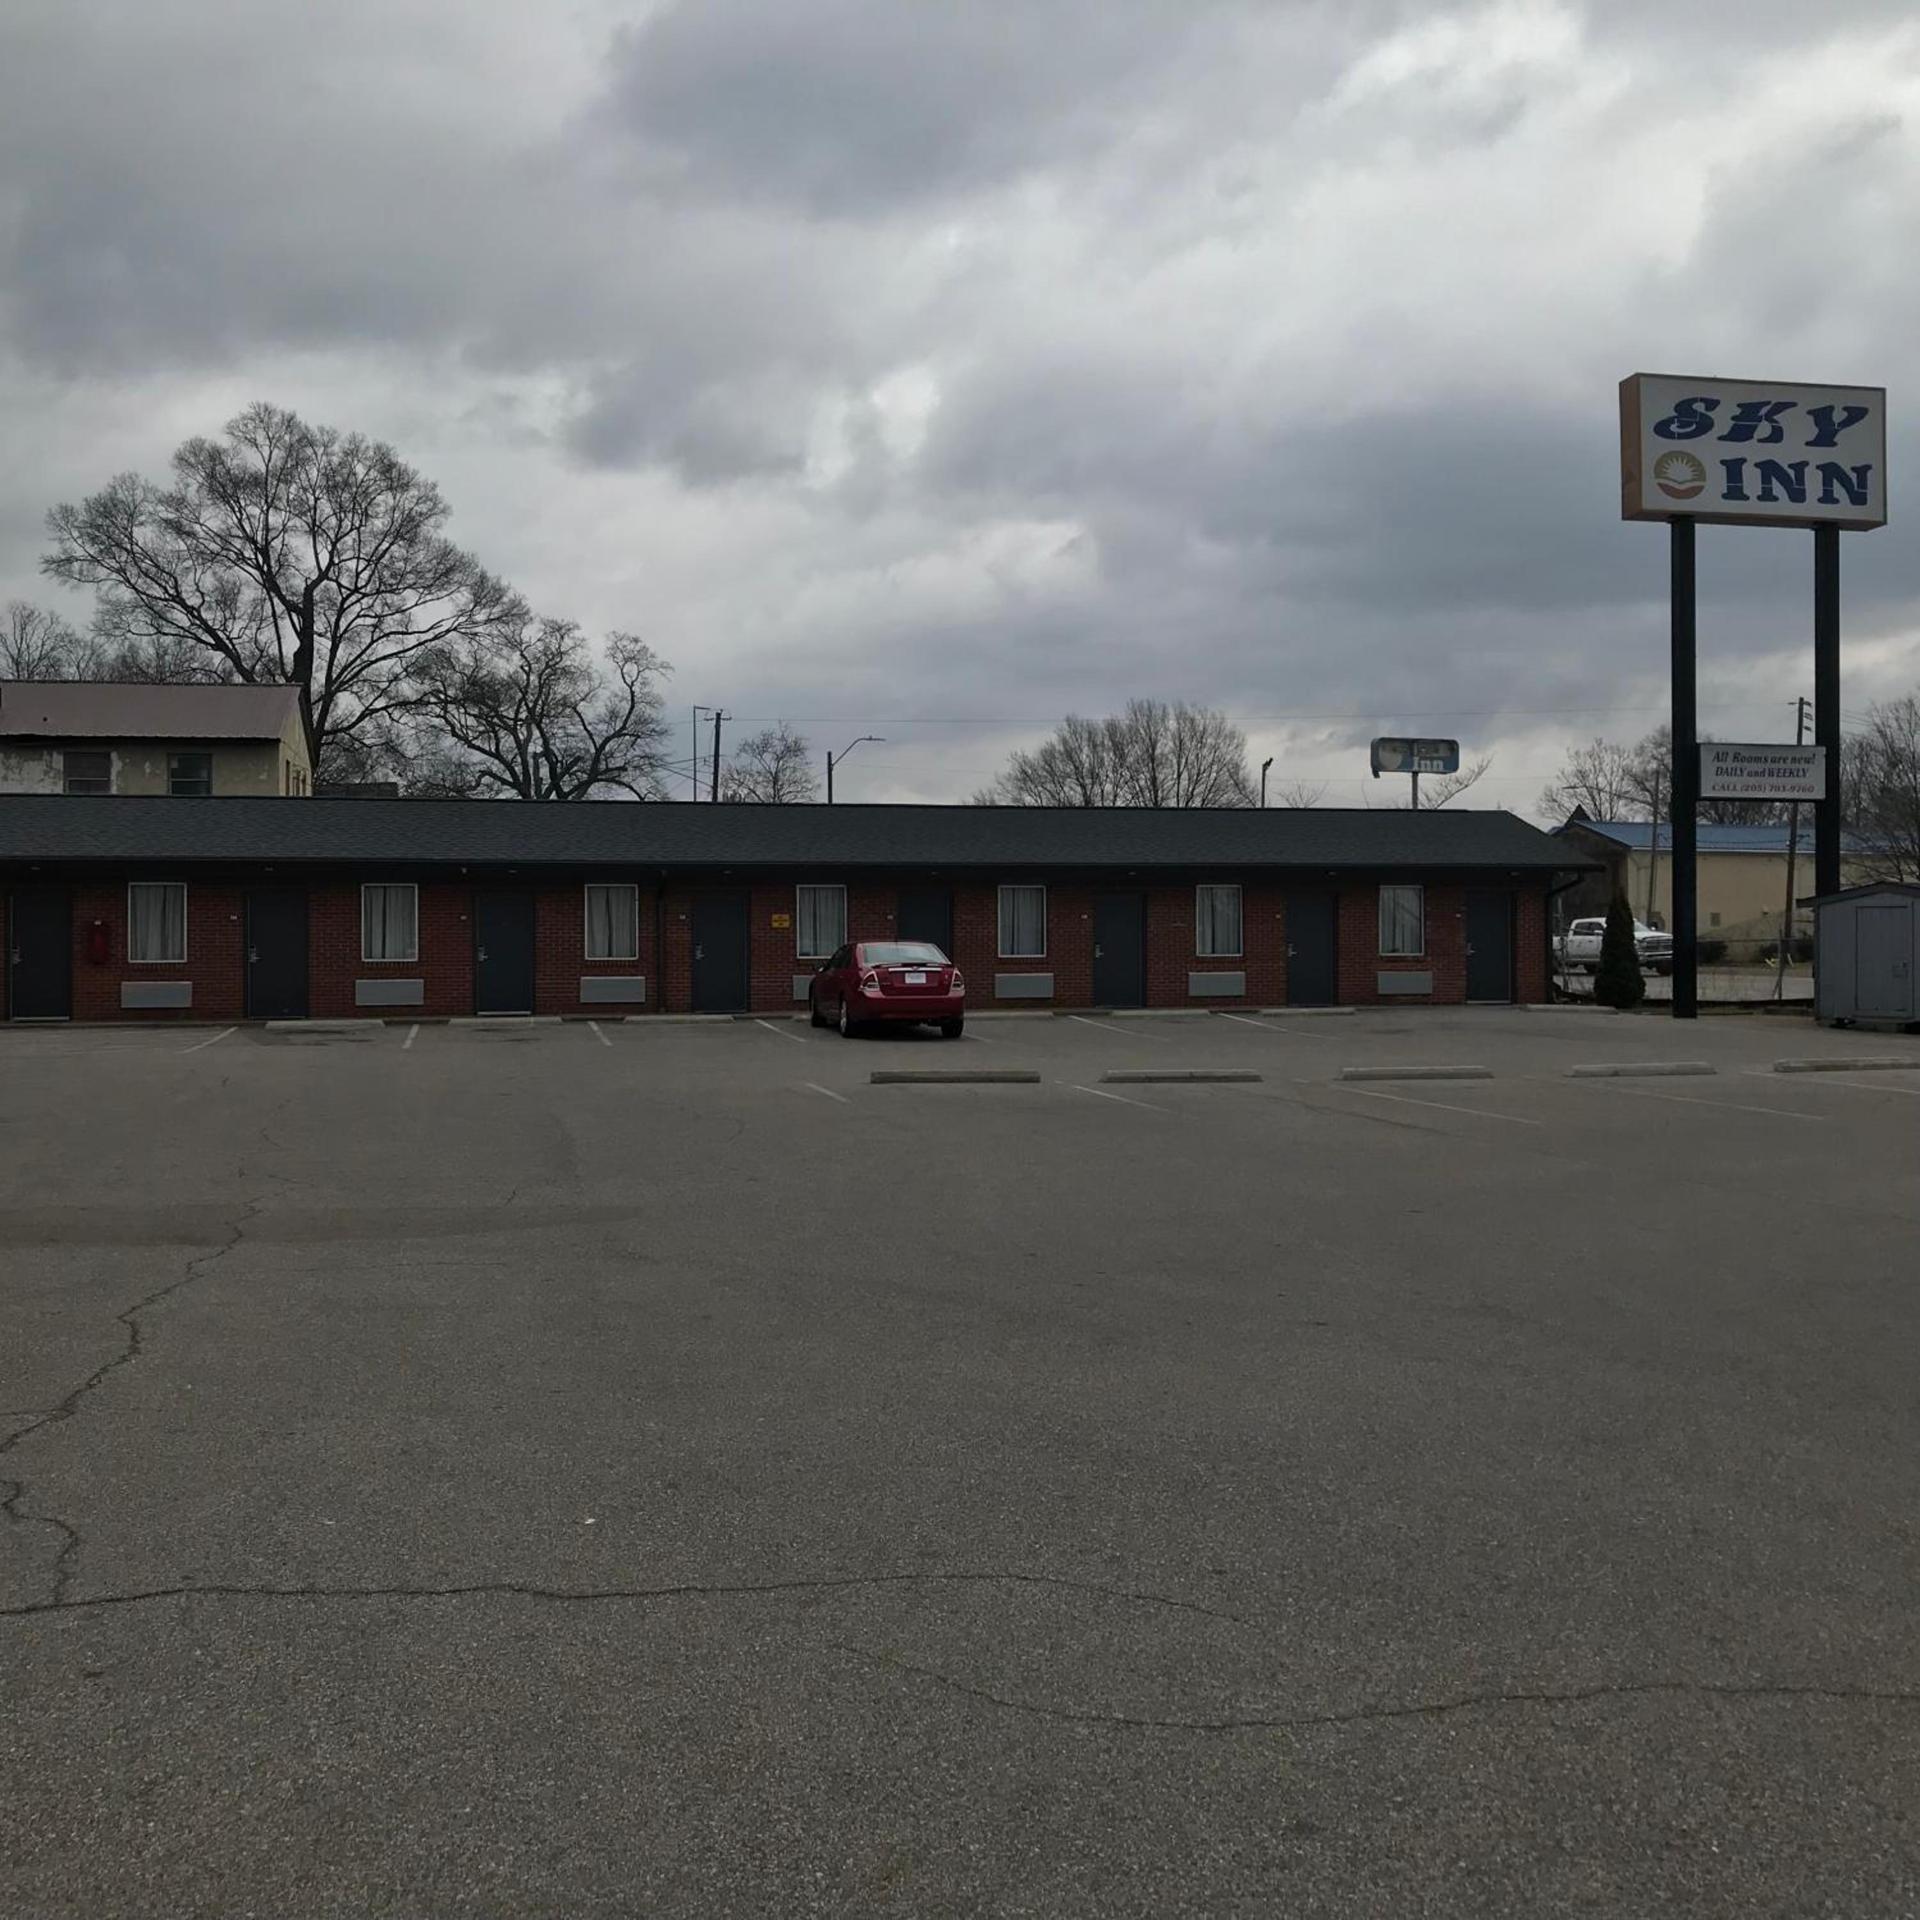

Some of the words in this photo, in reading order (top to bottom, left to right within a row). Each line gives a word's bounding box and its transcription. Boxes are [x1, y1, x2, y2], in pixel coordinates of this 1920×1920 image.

[1653, 397, 1869, 447] SKY
[1720, 457, 1872, 506] INN
[1712, 751, 1729, 763] All
[1732, 752, 1769, 765] Rooms
[1770, 755, 1789, 765] are
[1790, 753, 1816, 765] new!
[1715, 766, 1747, 777] DAILY
[1747, 767, 1766, 778] and
[1766, 767, 1809, 779] WEEKLY
[1712, 783, 1738, 792] CALL
